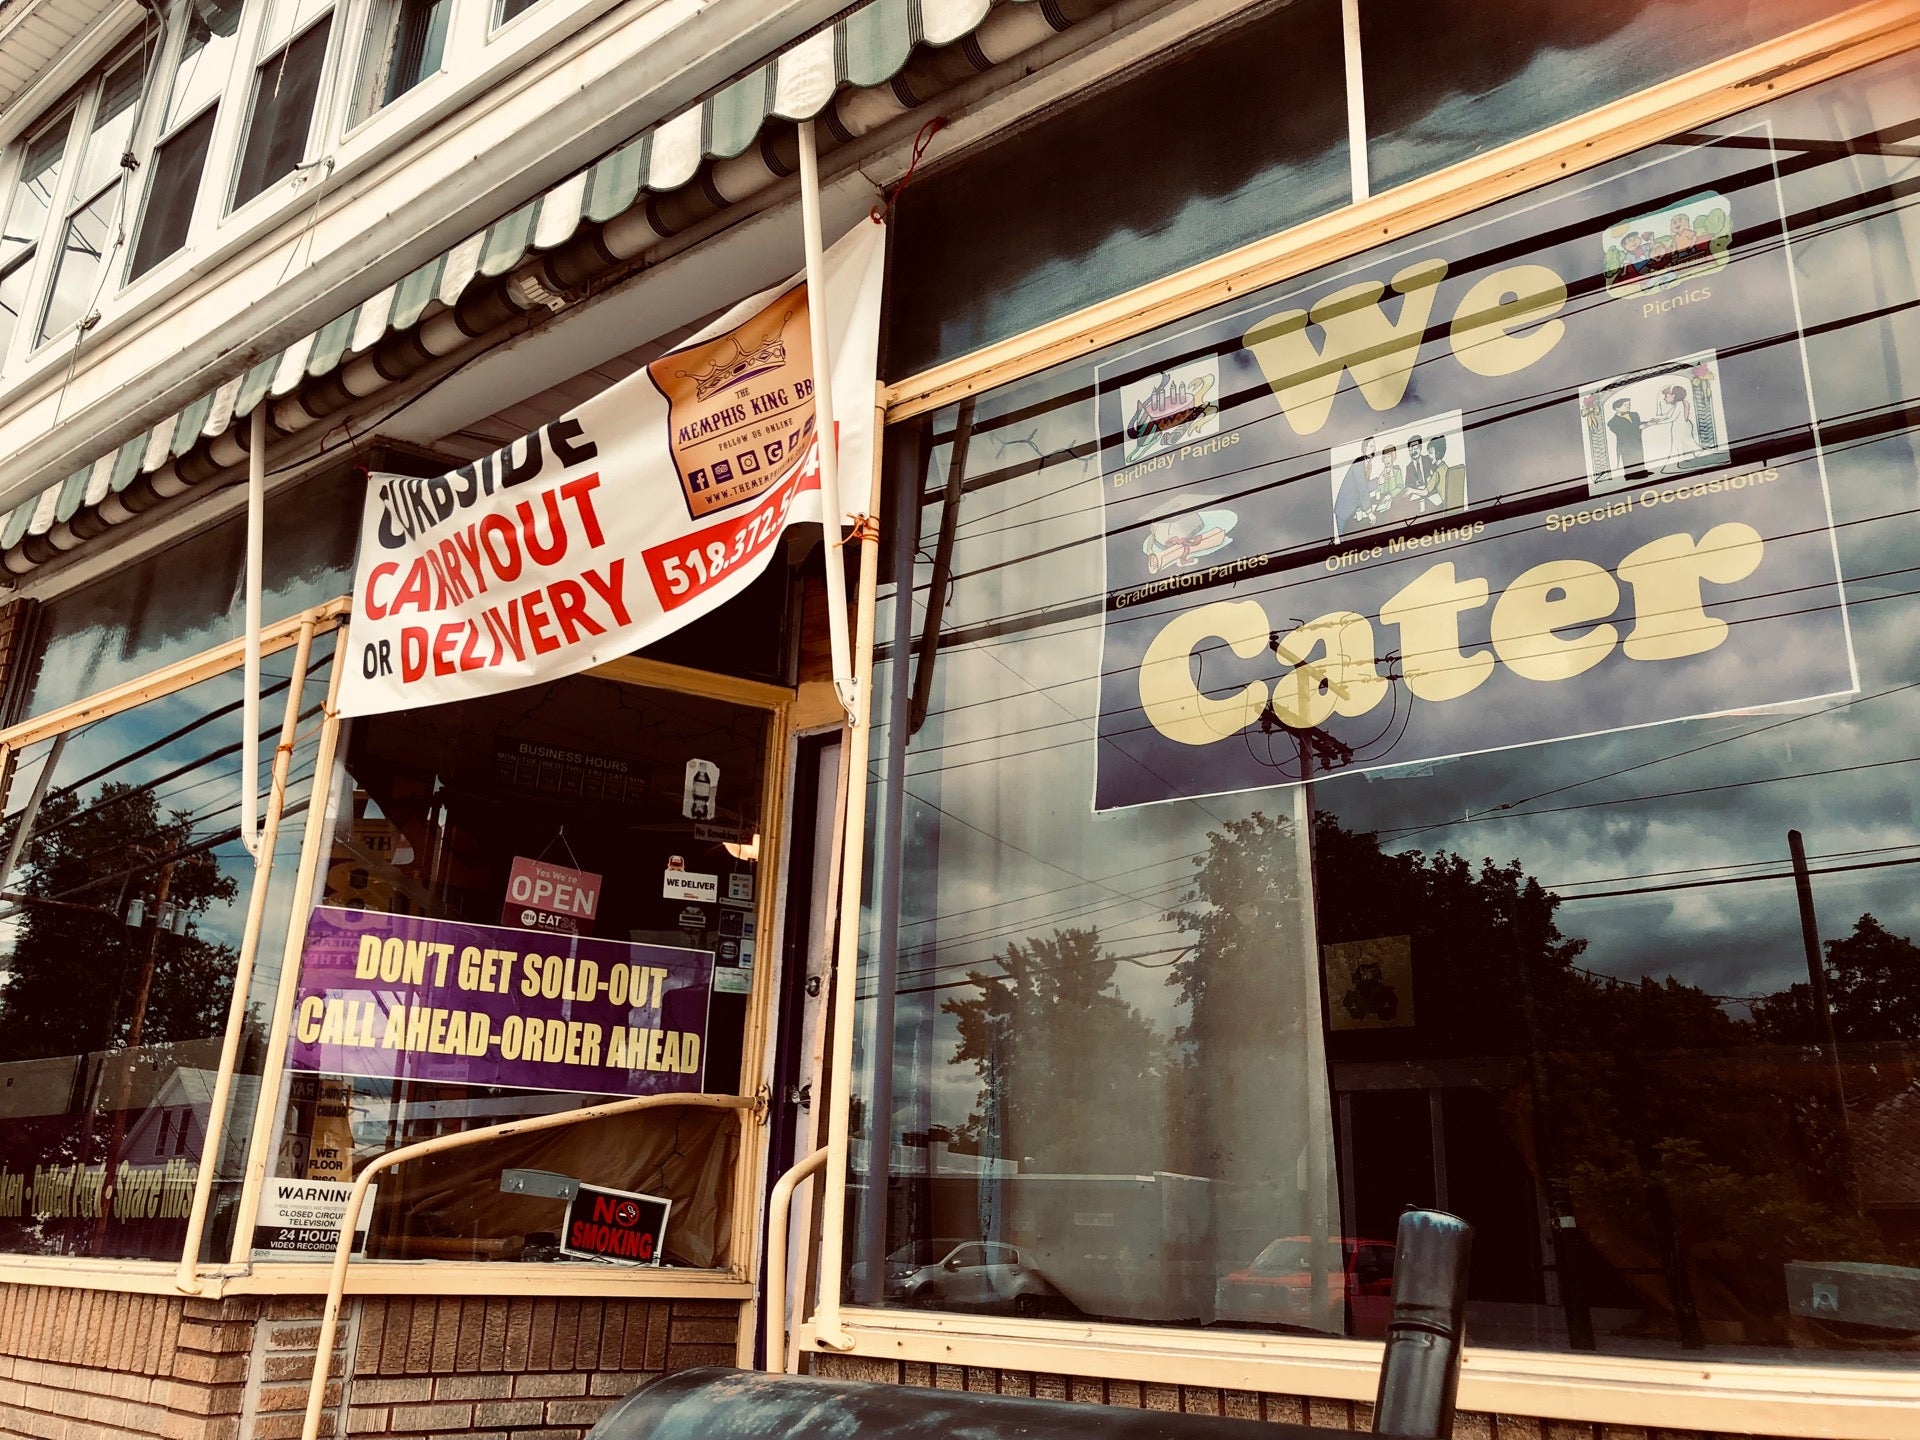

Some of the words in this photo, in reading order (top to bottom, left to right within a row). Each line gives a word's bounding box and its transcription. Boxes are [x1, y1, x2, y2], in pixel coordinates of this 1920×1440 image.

[1642, 285, 1712, 319] Picnics
[1242, 258, 1567, 435] We
[678, 404, 746, 445] MEMPHIS
[750, 389, 789, 416] KING
[793, 378, 815, 400] BB
[735, 387, 750, 399] THE
[718, 436, 748, 452] FOLLOW
[752, 428, 762, 439] US
[766, 418, 793, 434] ONLINE
[1113, 450, 1176, 488] Birthday
[1179, 430, 1240, 463] Parties
[1545, 496, 1634, 533] Special
[1639, 465, 1779, 509] Occasions
[365, 472, 605, 621] CARRYOUT
[1325, 546, 1383, 573] Office
[1388, 519, 1484, 556] Meetings
[1115, 571, 1203, 609] Graduation
[1208, 552, 1269, 587] Parties
[362, 639, 393, 679] OR
[401, 558, 632, 684] DELIVERY
[1139, 522, 1764, 746] Cater
[519, 743, 582, 764] BUSINESS
[585, 756, 628, 773] HOURS
[696, 827, 705, 837] No
[707, 829, 738, 841] Smoking
[535, 867, 551, 878] Yes
[552, 871, 578, 884] We're
[667, 878, 680, 886] WE
[681, 880, 715, 891] DELIVER
[512, 875, 595, 915] OPEN
[355, 934, 454, 988] DON'T
[457, 945, 518, 995] GET
[521, 952, 667, 1009] SOLD-OUT
[296, 995, 376, 1048] CALL
[382, 1004, 602, 1067] AHEAD-ORDER
[606, 1027, 700, 1074] AHEAD
[309, 1160, 343, 1171] FLOOR
[316, 1149, 339, 1159] WET
[113, 1160, 163, 1225] Spare
[279, 1209, 313, 1219] CLOSED
[315, 1212, 346, 1220] CIRCUI
[289, 1218, 336, 1228] TELEVISION
[270, 1241, 295, 1249] VIDEO
[296, 1242, 338, 1251] RECORDIN
[278, 1229, 295, 1240] 24
[571, 1221, 653, 1259] SMOKING
